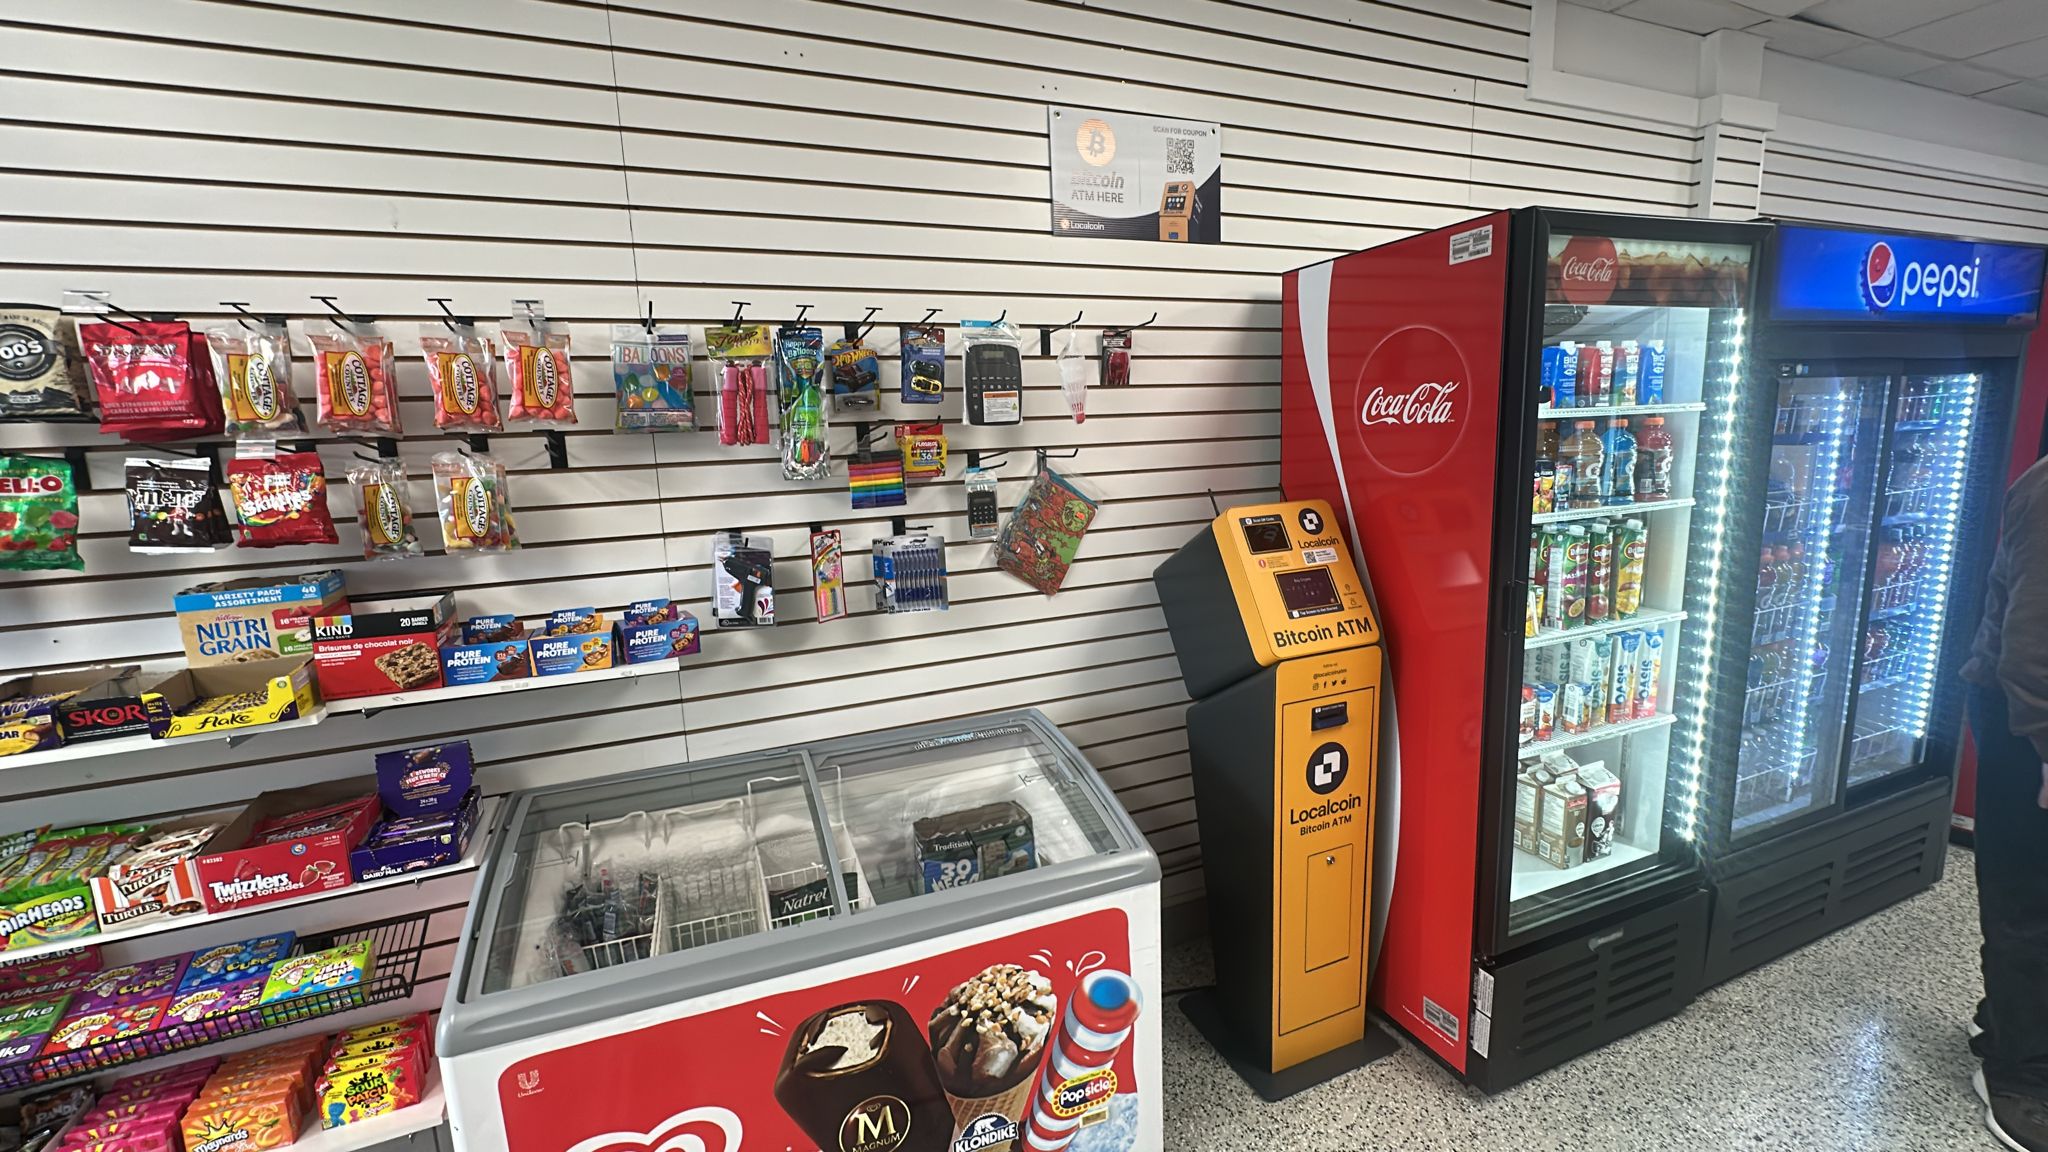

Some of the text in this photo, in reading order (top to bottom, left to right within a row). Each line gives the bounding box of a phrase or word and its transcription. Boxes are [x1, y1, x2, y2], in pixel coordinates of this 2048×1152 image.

[1170, 127, 1182, 135] FOR
[1183, 128, 1208, 137] COUPON
[1072, 189, 1124, 203] ATM HERE
[1070, 220, 1105, 231] Localcoin
[1563, 256, 1616, 283] Coca-Cola
[1901, 257, 1981, 307] pepsi
[623, 346, 686, 363] BALOONS
[351, 359, 367, 409] COTTAGE
[462, 360, 476, 409] COTTAGE
[543, 354, 555, 403] COTTAGE
[1361, 381, 1460, 425] Coca-Cola
[921, 453, 932, 461] 36
[473, 484, 487, 530] COTTAGE
[1298, 536, 1340, 550] Localcoin
[212, 585, 317, 603] VARIETY PACK 40
[215, 595, 283, 609] ASSORTIMENT
[630, 606, 658, 615] PROTEIN
[635, 602, 652, 610] PURE
[197, 618, 268, 642] NUTRI
[400, 617, 411, 627] 20
[553, 615, 583, 624] PROTEIN
[316, 624, 354, 638] KIND
[629, 634, 667, 646] PROTEIN
[635, 629, 659, 638] PURE
[1273, 617, 1373, 647] Bitcoin ATM
[199, 632, 272, 656] GRAIN
[318, 638, 415, 653] Brisures de chocolat noir
[454, 649, 482, 660] PURE
[536, 647, 578, 659] PROTEIN
[543, 641, 569, 651] PURE
[447, 655, 491, 667] PROTEIN
[1615, 663, 1628, 705] OASIS
[1638, 659, 1653, 700] OASIS
[67, 704, 148, 728] SKOR
[1290, 794, 1361, 825] Localcoin
[1300, 814, 1352, 836] Bitcoin ATM
[362, 870, 385, 881] DAIRY
[385, 868, 403, 876] MILK
[940, 858, 972, 880] 30
[209, 872, 291, 899] Twizzlers
[217, 881, 305, 904] twists torsades
[783, 887, 828, 914] Natrel
[1, 895, 85, 937] AIRHEADS
[104, 902, 162, 924] TURTLES
[23, 1006, 54, 1018] Ike
[346, 1078, 384, 1096] SOUR
[346, 1085, 388, 1107] PATCH
[854, 1105, 897, 1146] M
[192, 1128, 249, 1152] Maynards
[852, 1132, 901, 1152] MAGNUM
[954, 1122, 1018, 1152] KLONDIKE
